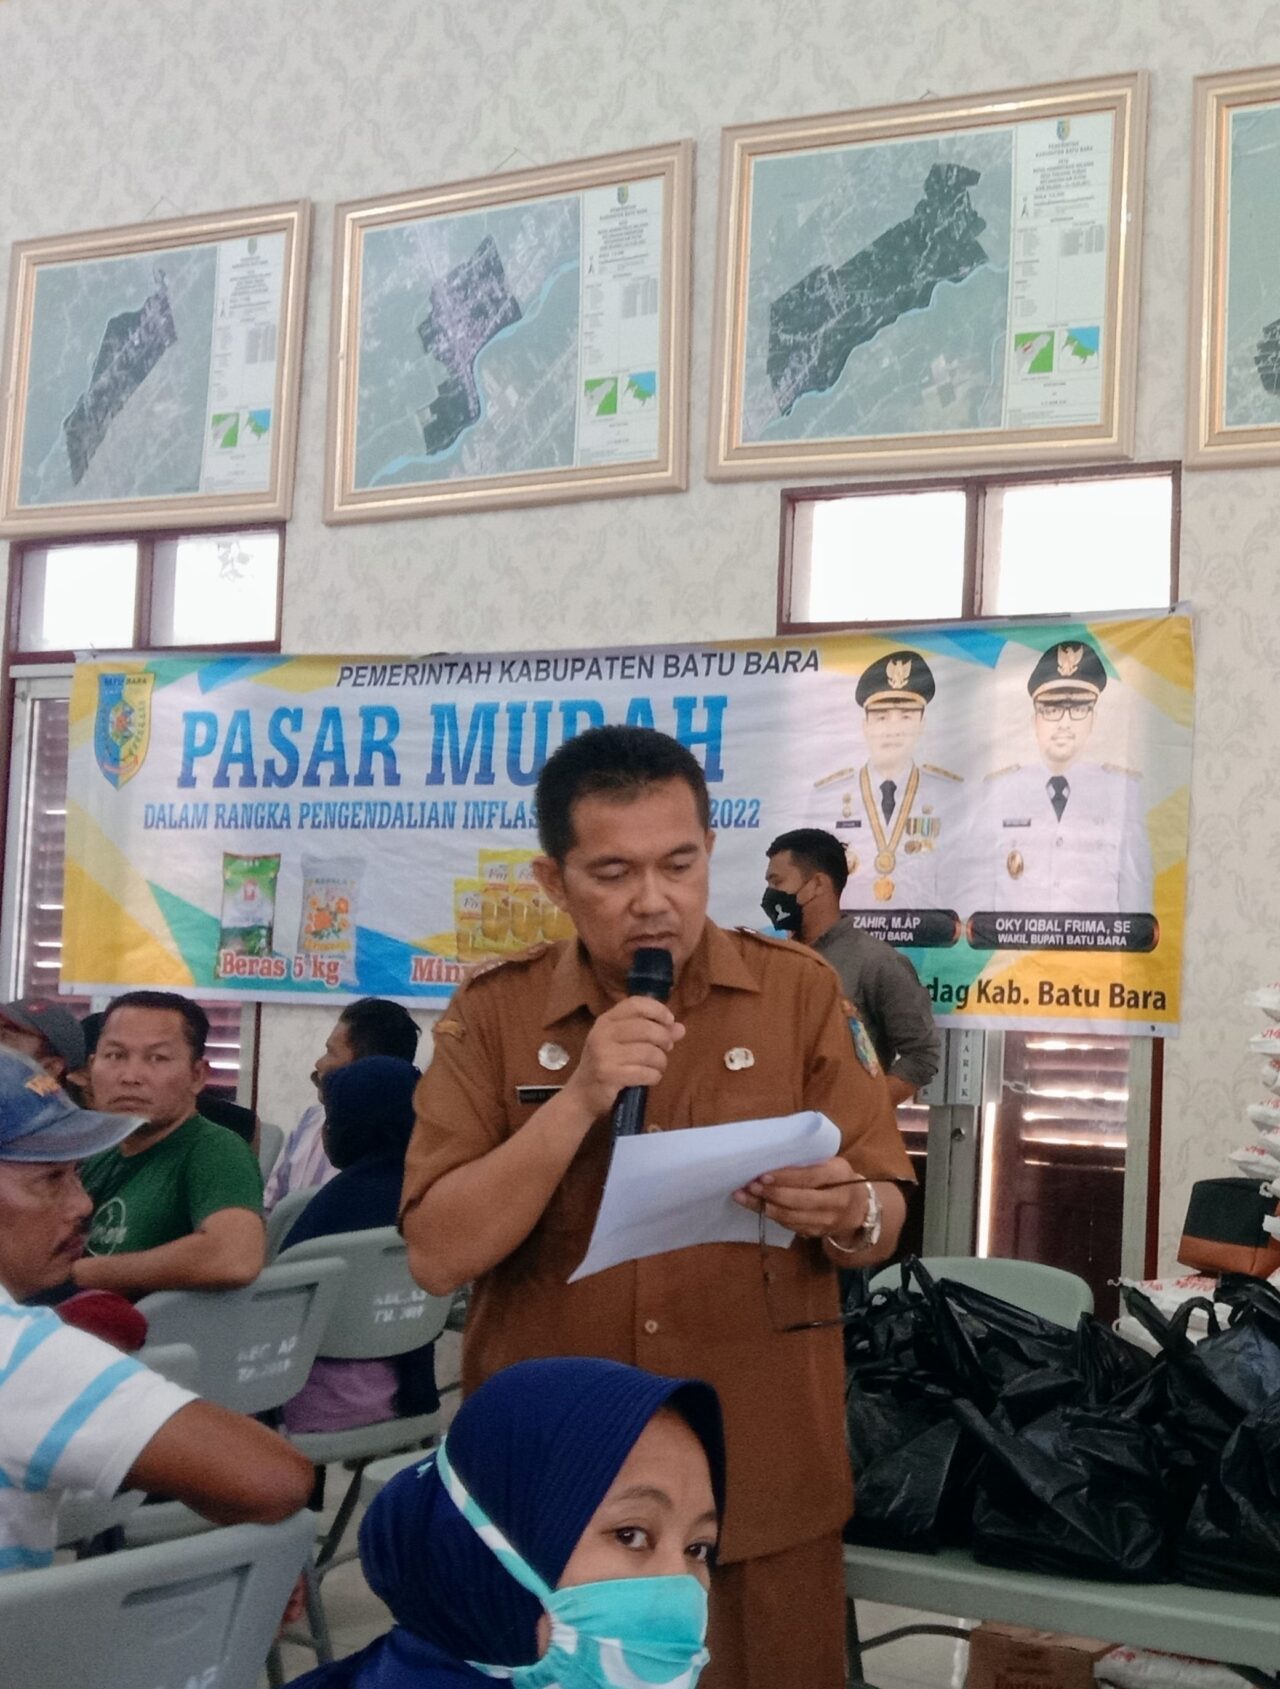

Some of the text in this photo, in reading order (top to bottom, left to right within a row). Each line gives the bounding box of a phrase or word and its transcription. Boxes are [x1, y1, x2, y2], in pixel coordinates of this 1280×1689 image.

[337, 650, 819, 687] PEMERINTAH KABUPATEN BATU BARA
[177, 705, 401, 789] PASAR
[144, 803, 209, 829] DALAM
[214, 802, 291, 829] RANGKA
[297, 800, 458, 829] PENGENDALIAN
[709, 798, 761, 829] 2022
[866, 931, 914, 942] ATU BARA
[995, 918, 1131, 934] OKY IQBAL FRIMA, SE
[998, 934, 1127, 947] WAKIL BUPATI BATU BARA
[221, 950, 340, 986] Beras 5 kg
[926, 977, 1167, 1011] dag Kab. Batu Bara
